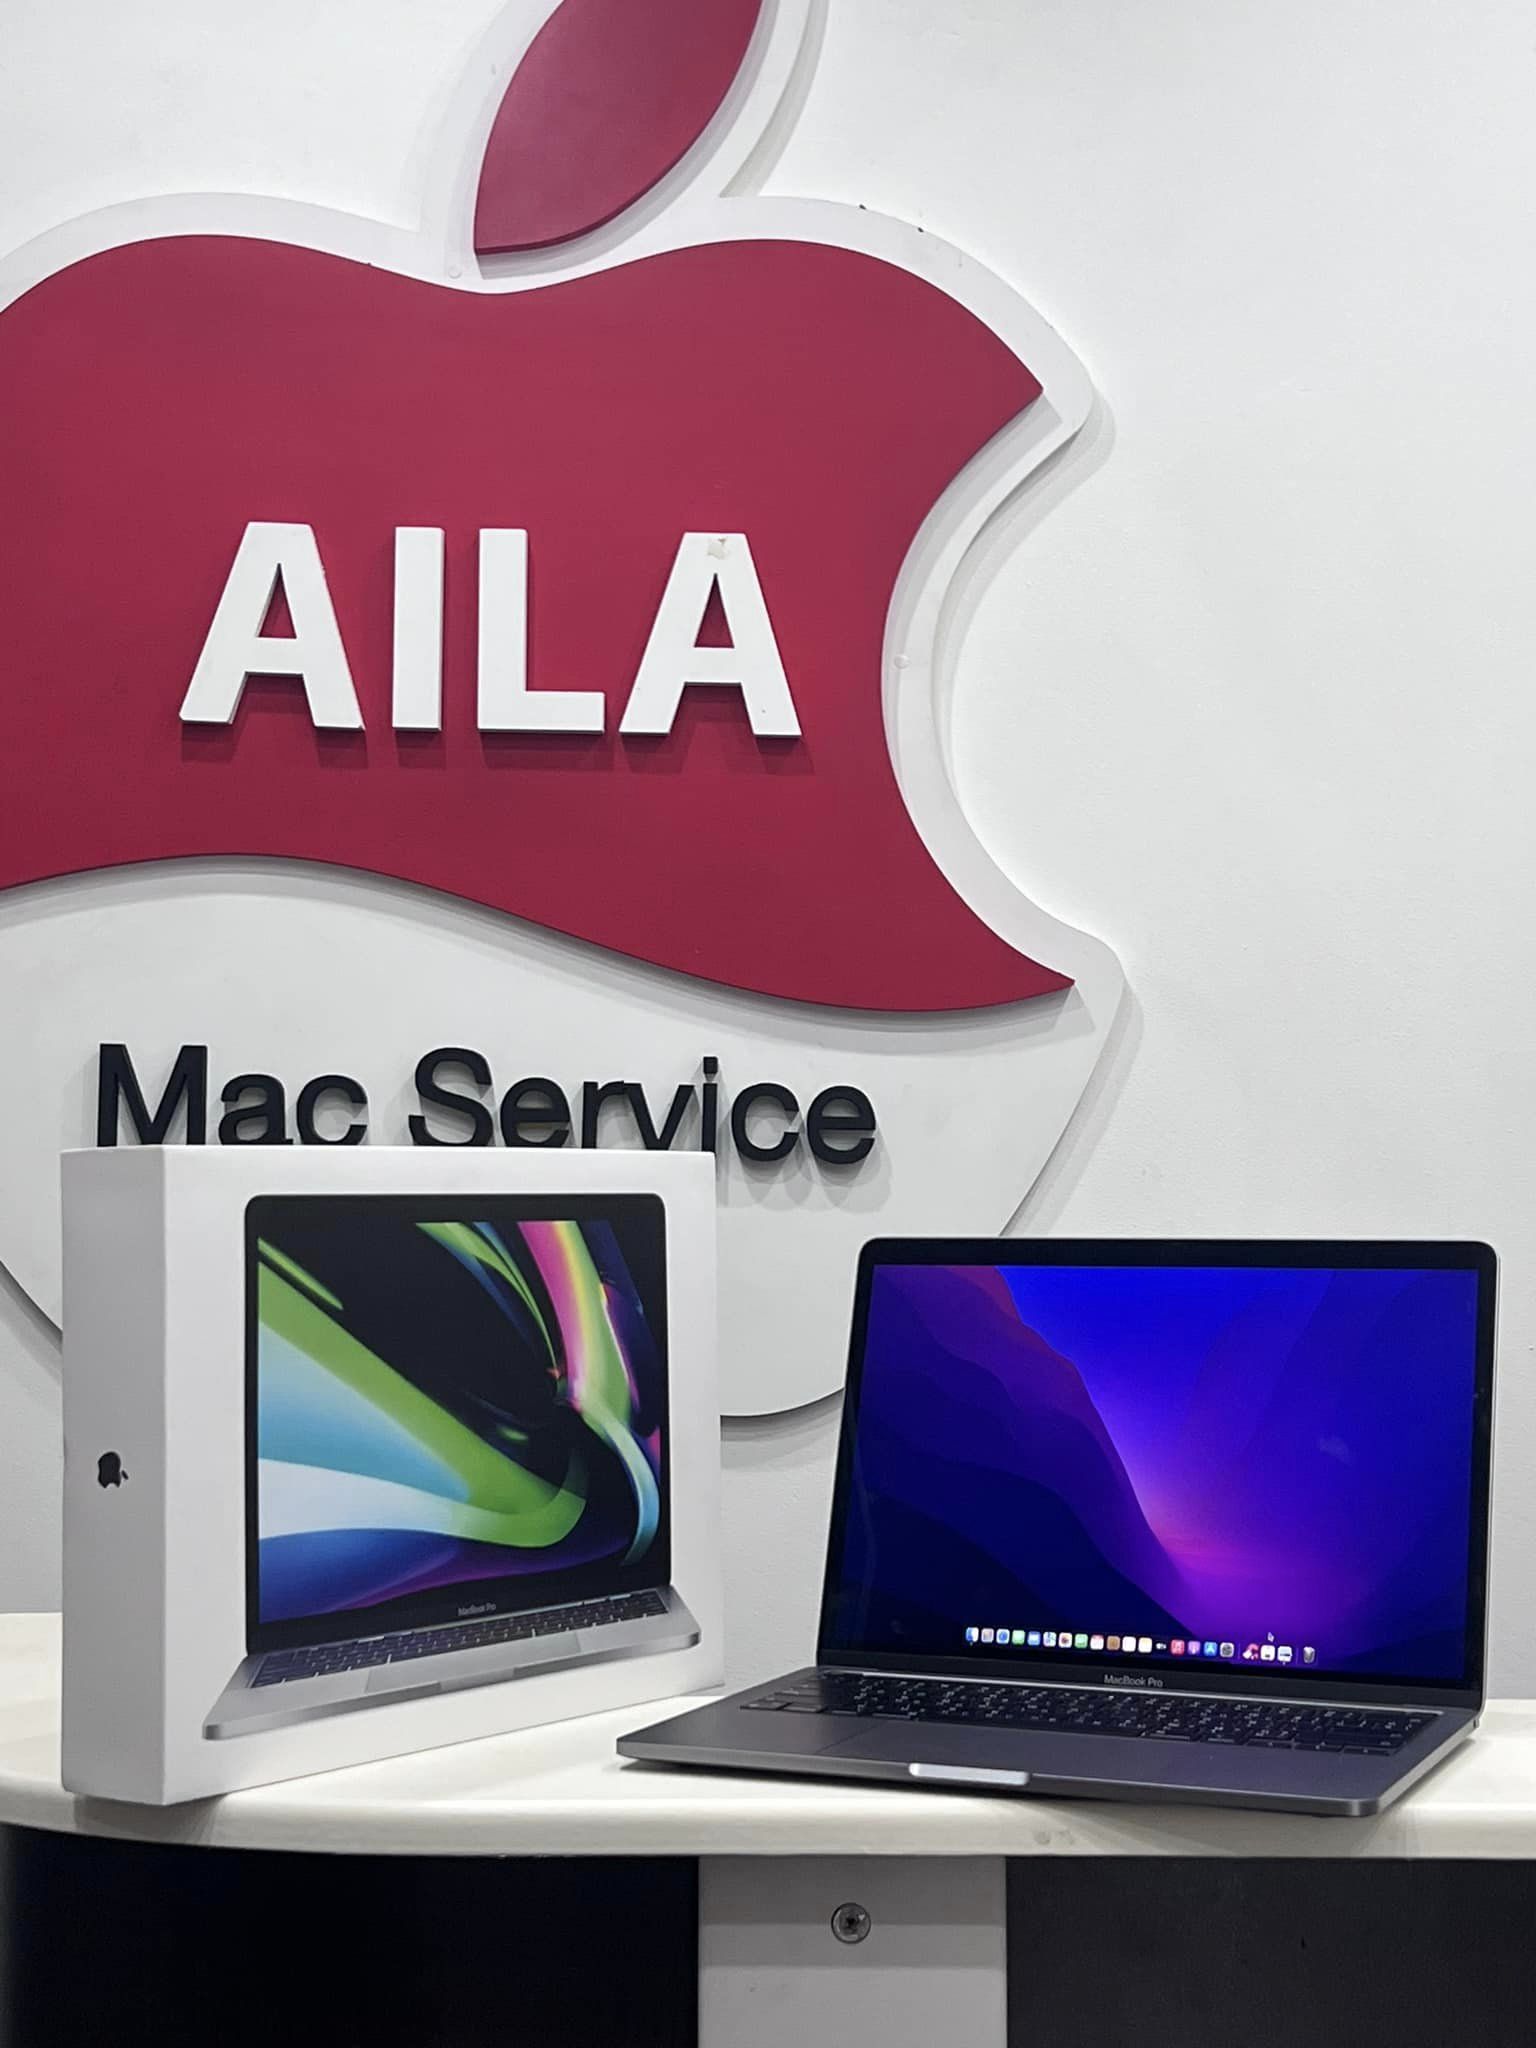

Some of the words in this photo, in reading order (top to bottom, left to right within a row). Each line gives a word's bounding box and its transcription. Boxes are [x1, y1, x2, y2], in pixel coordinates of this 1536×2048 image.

[179, 522, 802, 738] AILA
[97, 1043, 368, 1146] Mac
[408, 1047, 877, 1164] Service
[1104, 1674, 1146, 1686] MacBook
[1147, 1676, 1164, 1688] Pro
